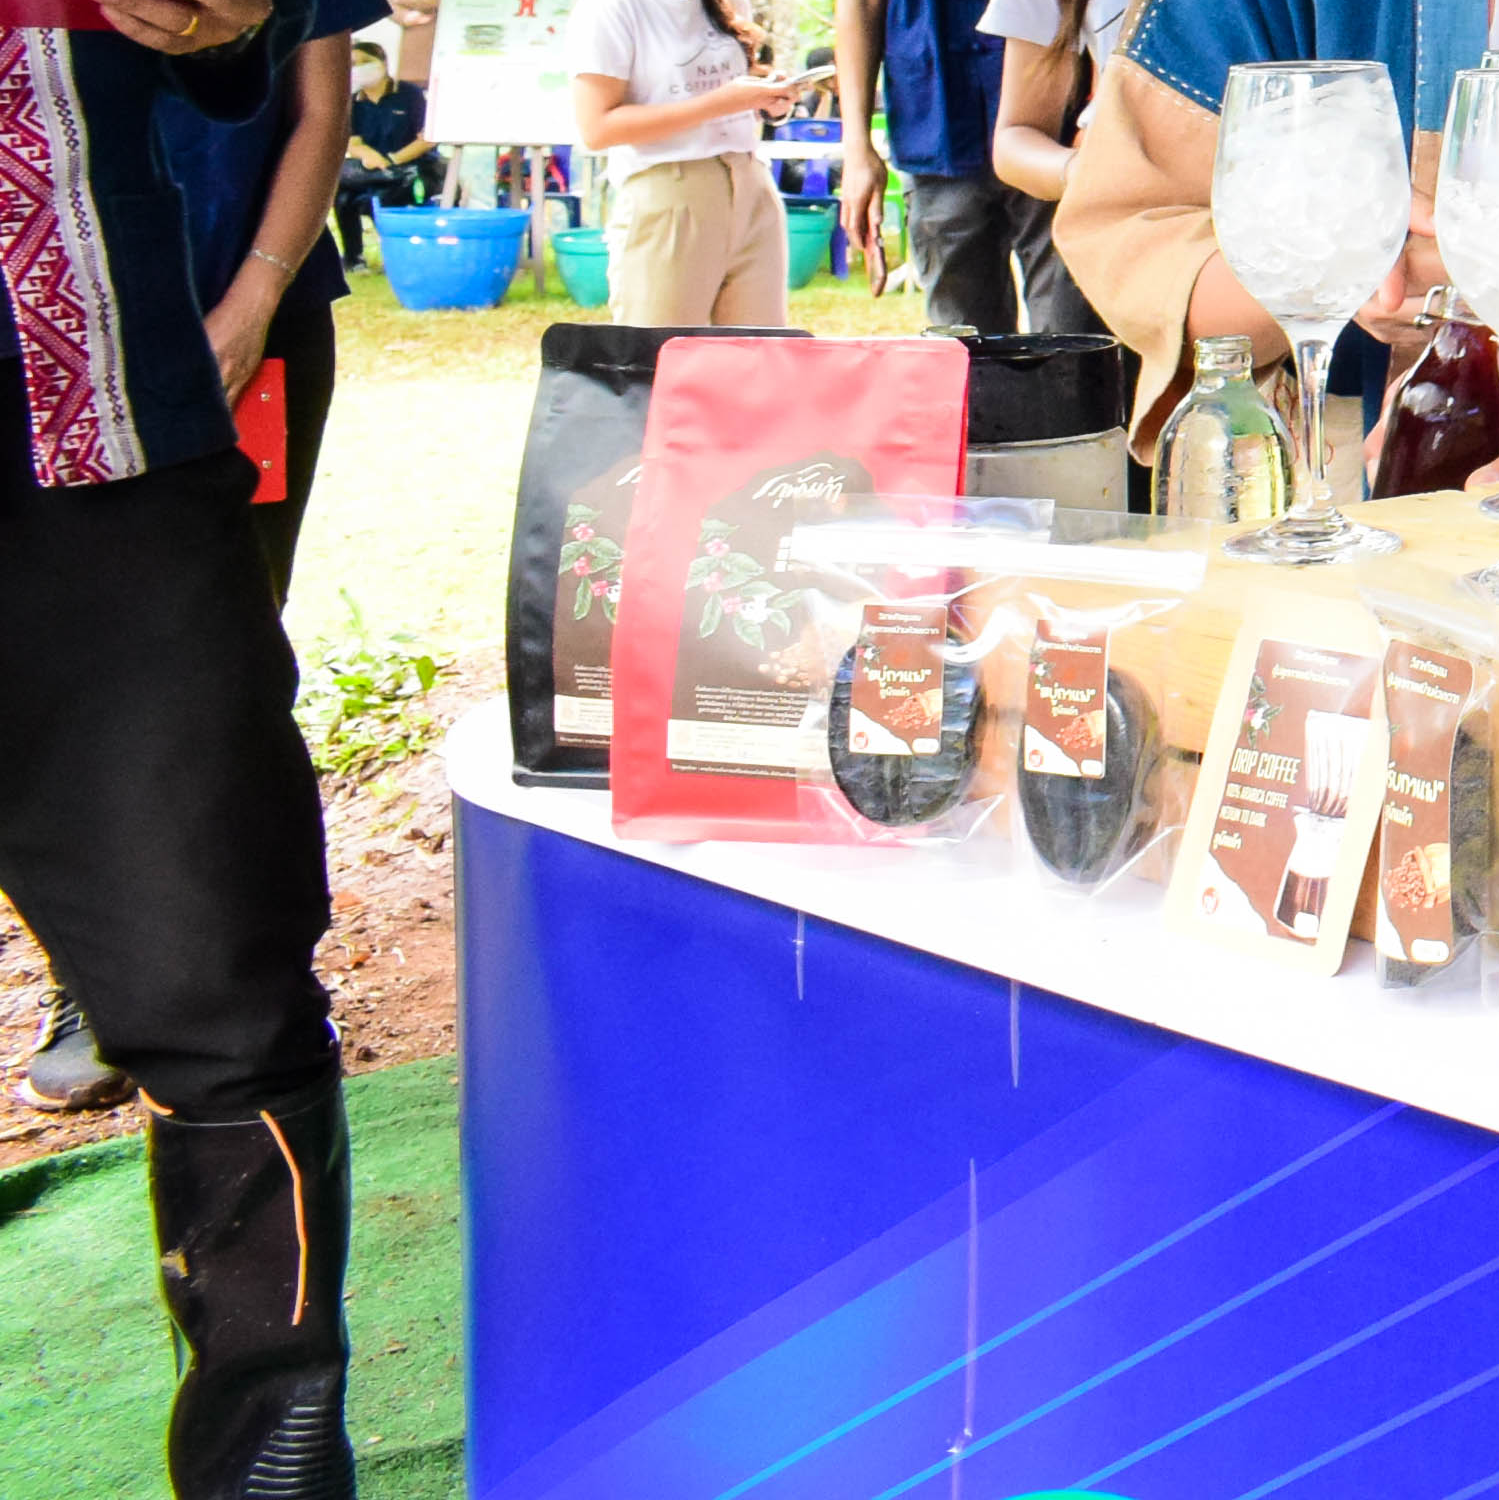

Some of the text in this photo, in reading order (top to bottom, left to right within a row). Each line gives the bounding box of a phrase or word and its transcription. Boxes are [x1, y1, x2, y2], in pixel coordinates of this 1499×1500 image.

[697, 61, 730, 76] NAN
[1231, 747, 1302, 785] DRIP COFFEE
